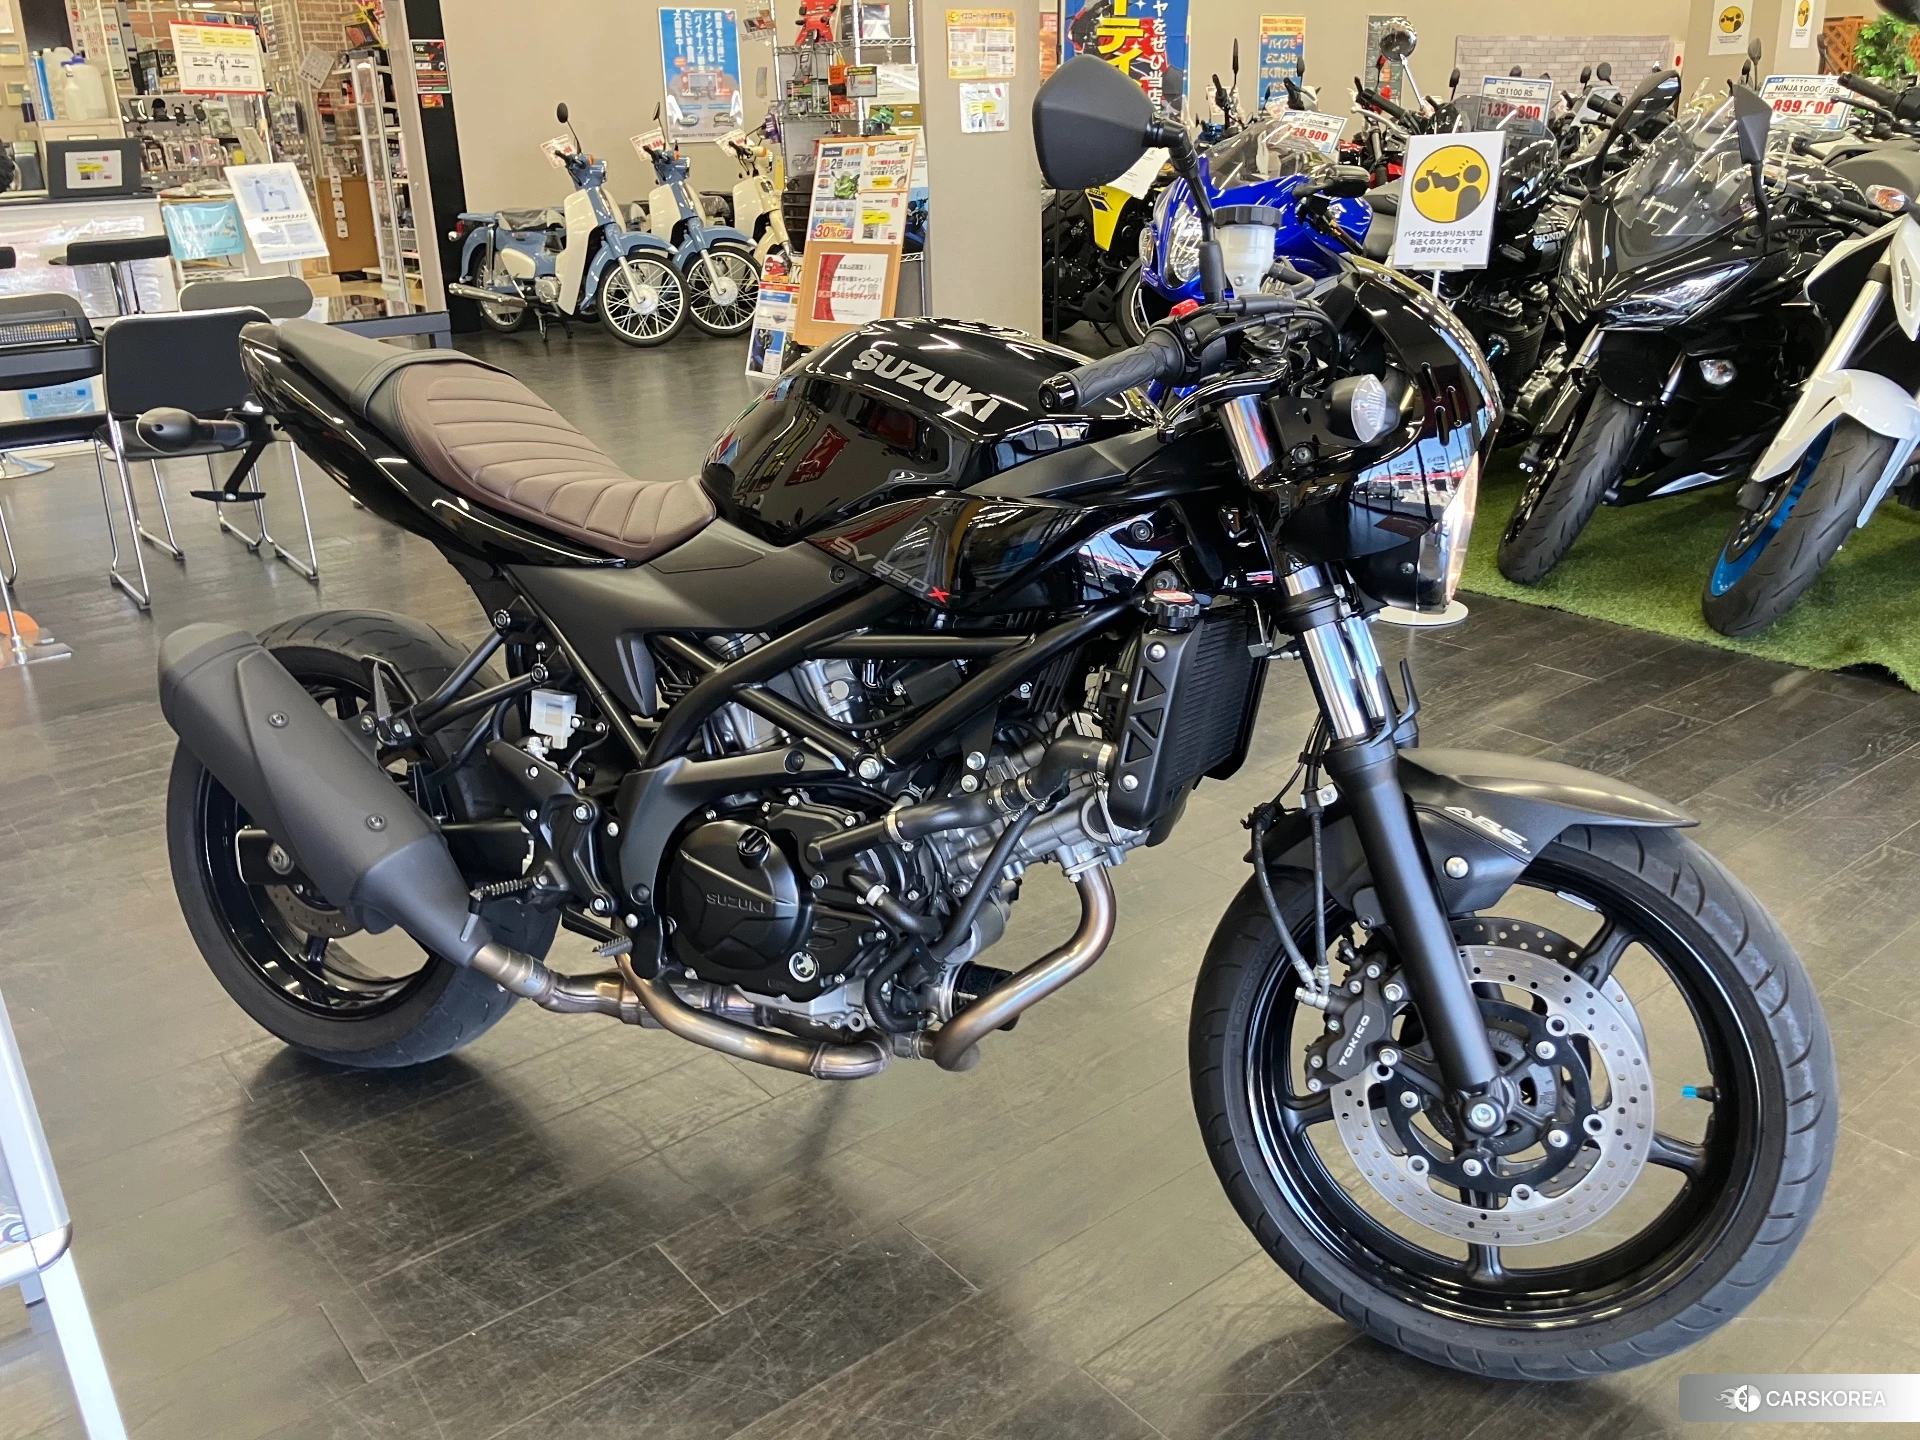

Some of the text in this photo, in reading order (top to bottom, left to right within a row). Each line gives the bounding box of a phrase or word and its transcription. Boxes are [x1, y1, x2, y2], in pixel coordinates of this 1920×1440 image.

[1268, 38, 1296, 49] バイクを
[1265, 53, 1298, 64] どこよりも
[1496, 87, 1534, 97] CB1100 RS
[1487, 102, 1542, 120] 1,33,900
[1772, 99, 1835, 115] 899,00
[1403, 229, 1484, 238] バイクにまたがりたい方は
[1533, 229, 1567, 243] HONDA
[1409, 238, 1476, 246] お近くのスタッフまで
[1413, 246, 1469, 254] お声がけください。
[851, 348, 1001, 423] SUZUKI
[705, 893, 766, 915] SUZUKI
[1338, 1014, 1371, 1067] TOKICO
